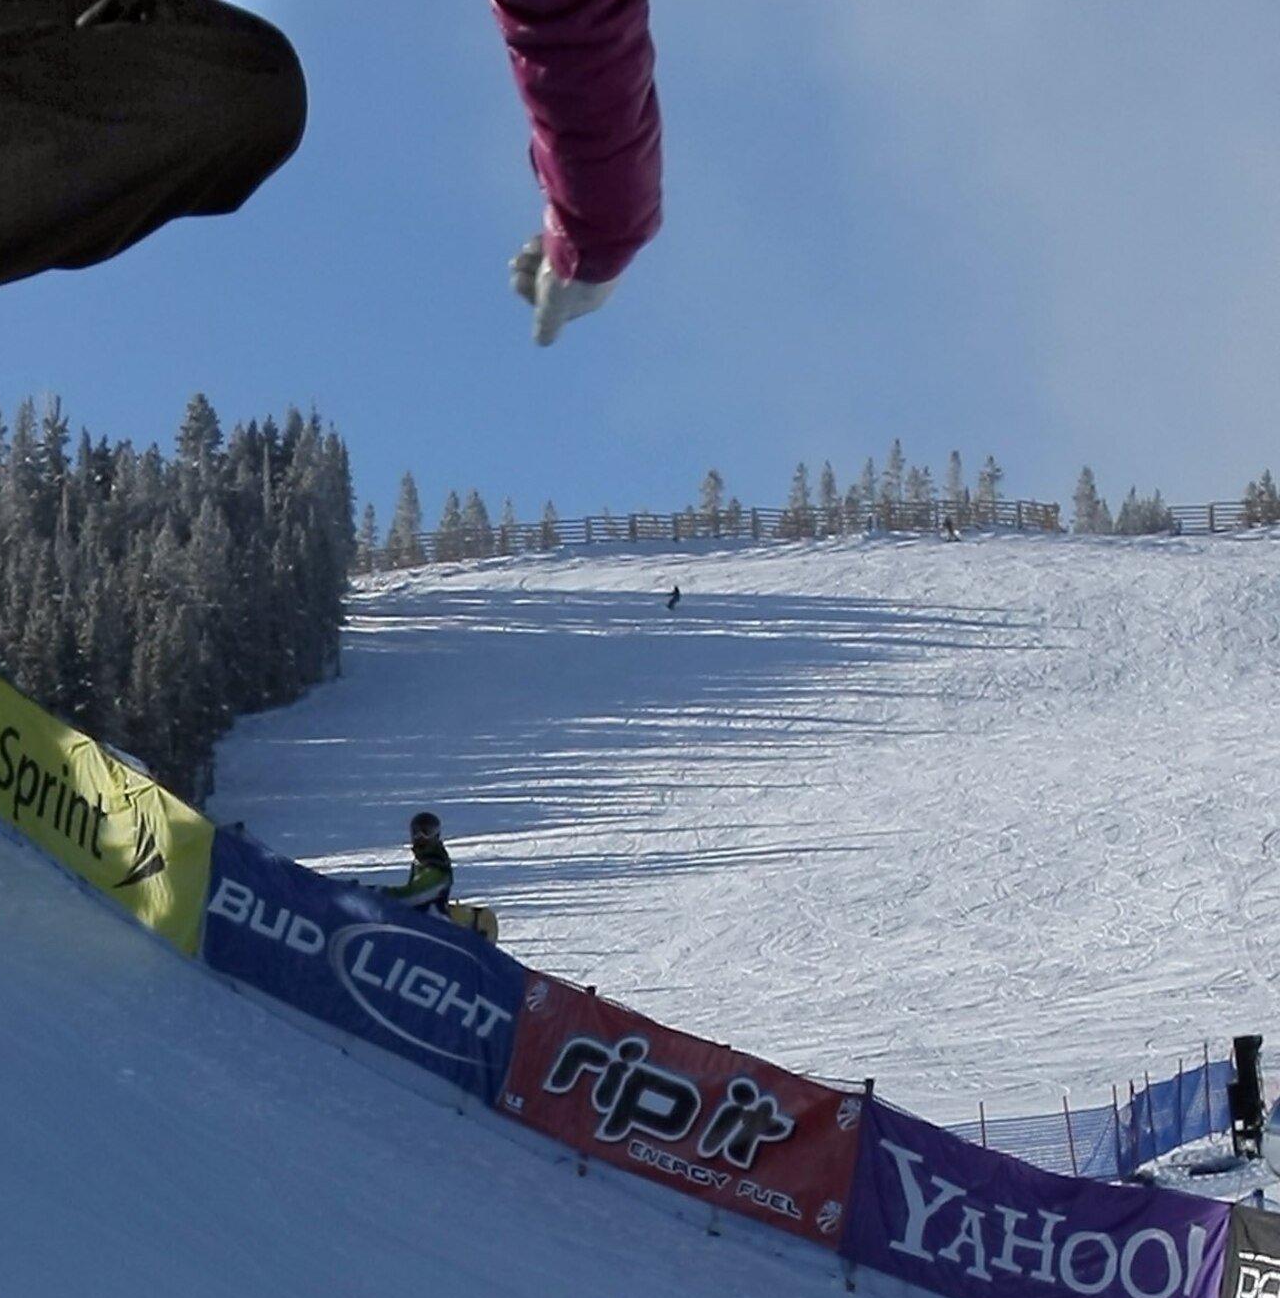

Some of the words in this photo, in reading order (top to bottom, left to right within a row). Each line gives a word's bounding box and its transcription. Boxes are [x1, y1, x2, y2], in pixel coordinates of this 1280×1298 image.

[207, 876, 326, 955] BUD
[350, 939, 513, 1039] LIGHT
[628, 1139, 732, 1189] ENERGY
[736, 1179, 803, 1220] FUEL
